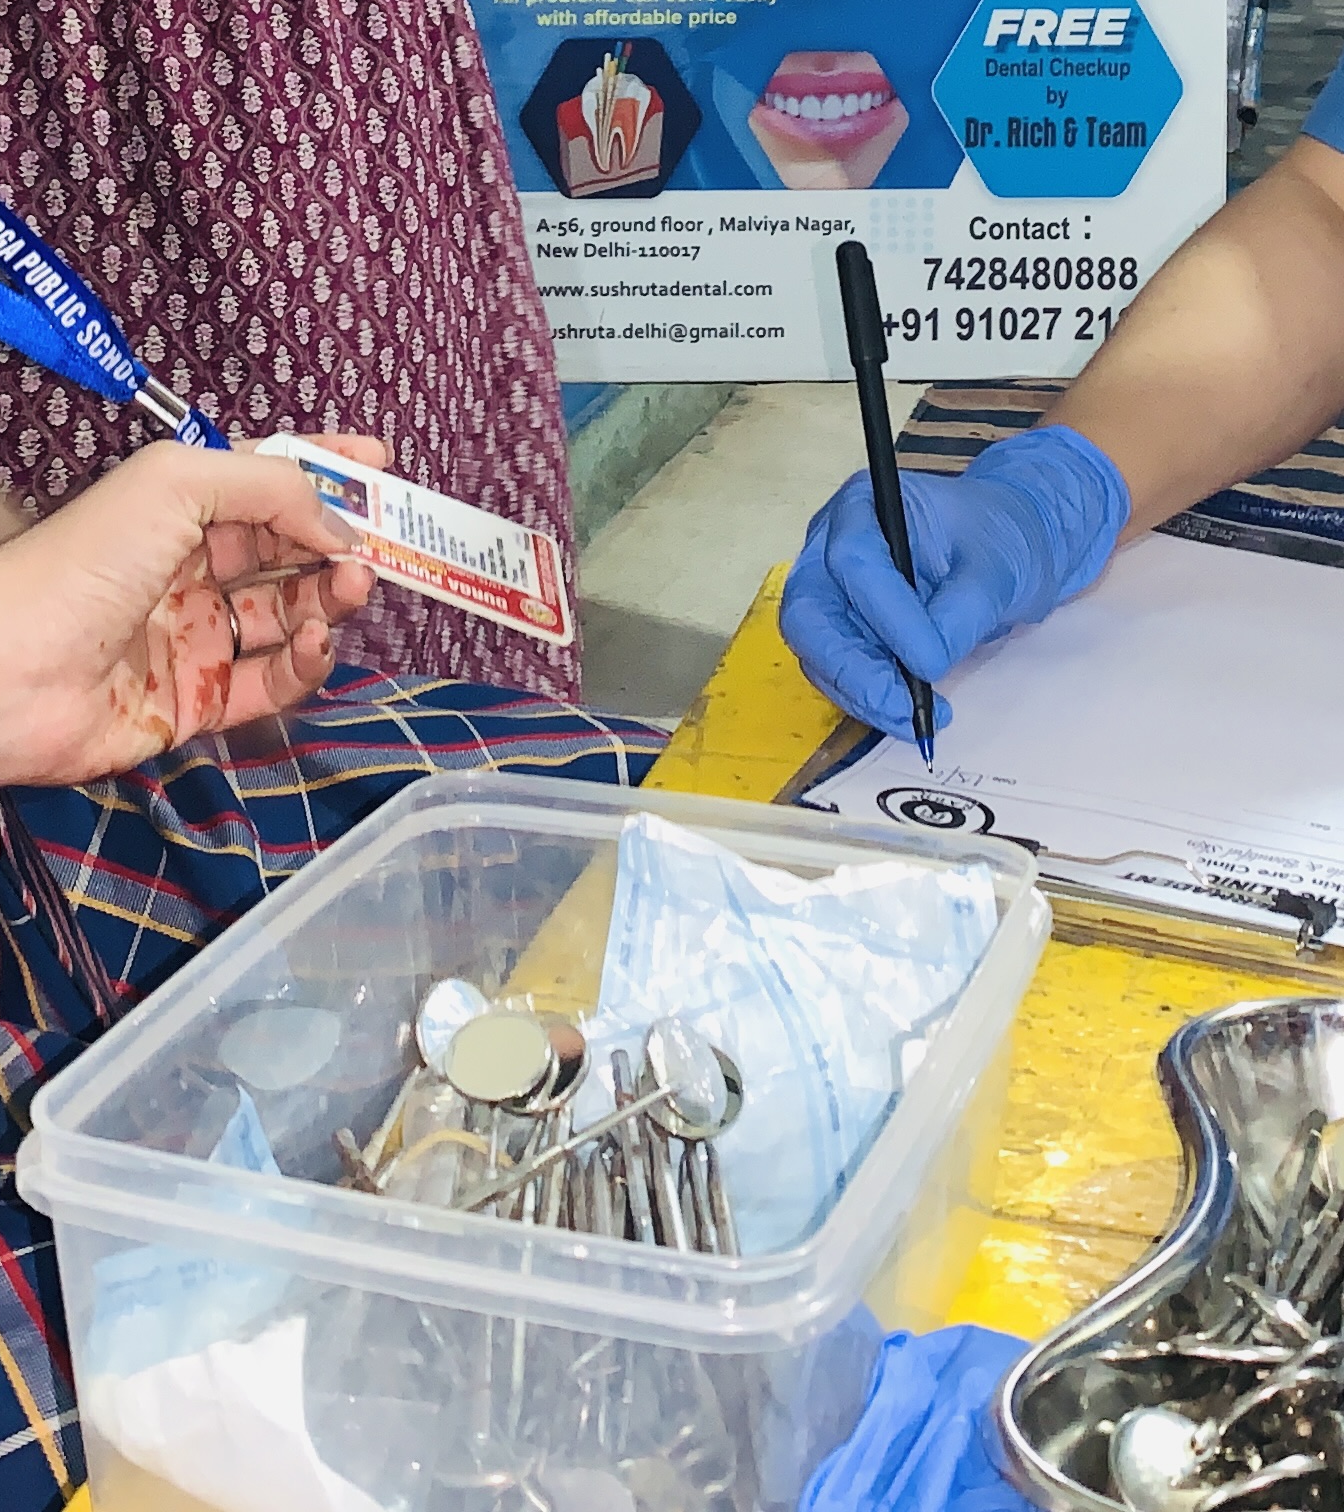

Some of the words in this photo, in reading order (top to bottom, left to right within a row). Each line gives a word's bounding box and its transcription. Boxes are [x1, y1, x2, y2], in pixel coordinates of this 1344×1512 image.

[536, 9, 578, 26] with
[583, 7, 683, 26] affordable
[688, 7, 738, 29] price
[983, 7, 1132, 48] FREE
[985, 58, 1044, 78] Dental
[1049, 57, 1131, 80] Checkup
[1046, 85, 1069, 109] by
[964, 116, 1002, 149] Dr.
[1007, 115, 1056, 148] Rich
[1063, 117, 1079, 148] &
[1086, 115, 1147, 148] Team
[536, 217, 585, 237] A-56,
[590, 216, 656, 235] ground
[660, 215, 704, 233] floor
[719, 215, 790, 236] Malviya
[795, 215, 856, 236] Nagar,
[968, 215, 1071, 240] Contact
[536, 242, 579, 259] New
[584, 241, 702, 261] Delhi-110017
[923, 256, 1139, 292] 7428480888
[537, 279, 773, 298] www.sushrutadental.com
[12, 250, 87, 329] PUBLIC
[76, 319, 139, 390] SCHO
[882, 307, 941, 342] +91
[955, 306, 1063, 342] 91027
[1074, 306, 1124, 341] 21
[1196, 855, 1249, 876] Clinic
[1256, 867, 1304, 885] Care
